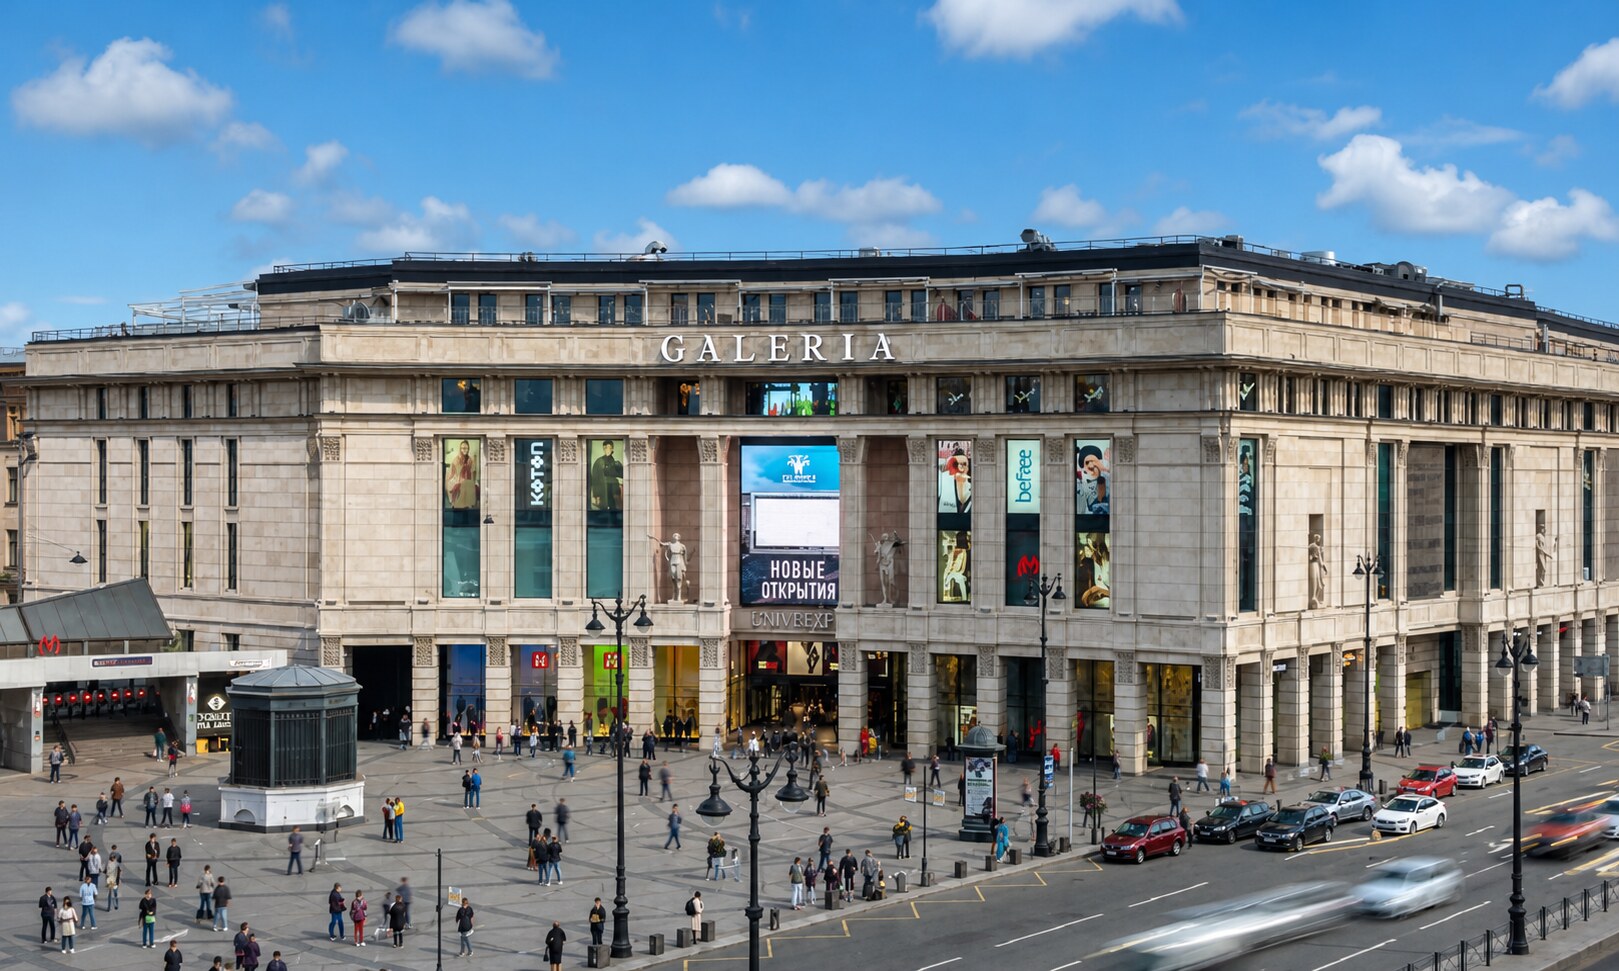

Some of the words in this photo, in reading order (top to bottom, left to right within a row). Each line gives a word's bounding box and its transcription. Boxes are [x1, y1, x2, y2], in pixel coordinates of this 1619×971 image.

[660, 333, 896, 363] GALERIA
[771, 560, 825, 579] НОВЫЕ
[761, 582, 836, 600] ОТКРЫТИЯ
